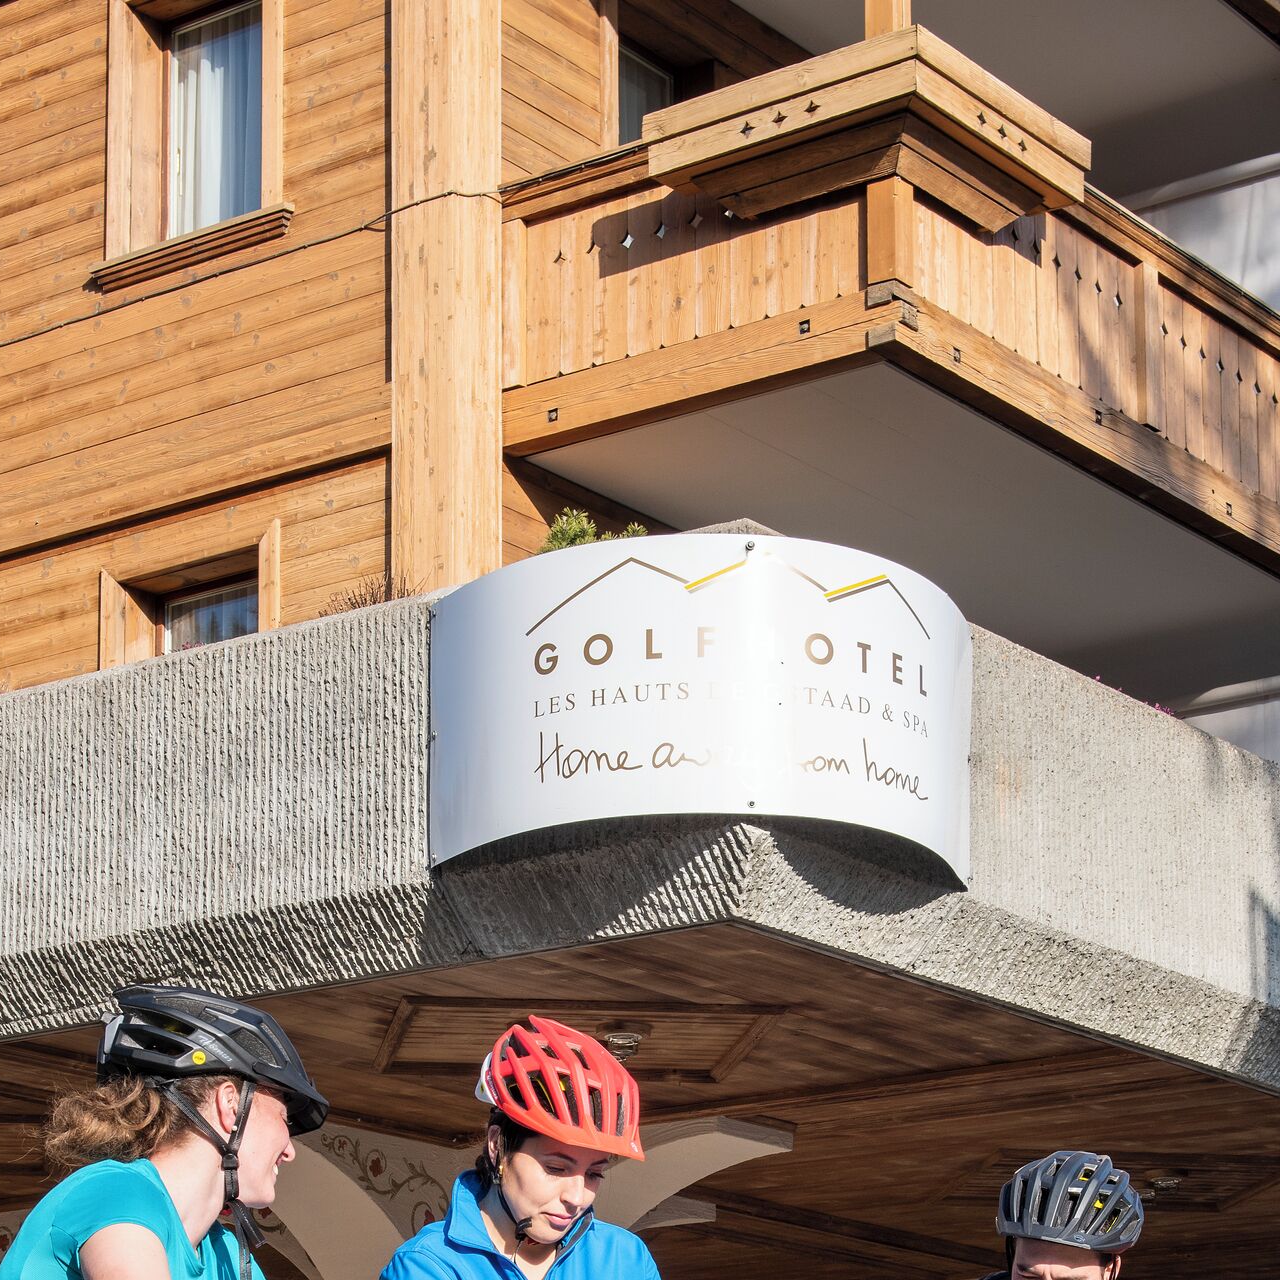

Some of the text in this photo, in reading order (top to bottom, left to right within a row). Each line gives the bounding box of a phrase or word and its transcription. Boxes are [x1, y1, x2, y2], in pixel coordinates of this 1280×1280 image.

[534, 626, 718, 675] GOLF
[804, 632, 927, 697] OTEL
[534, 693, 576, 718] LES
[591, 682, 690, 706] HAUTS
[882, 703, 894, 722] &
[903, 710, 929, 738] SPA
[534, 731, 643, 783] Home
[863, 738, 929, 801] home
